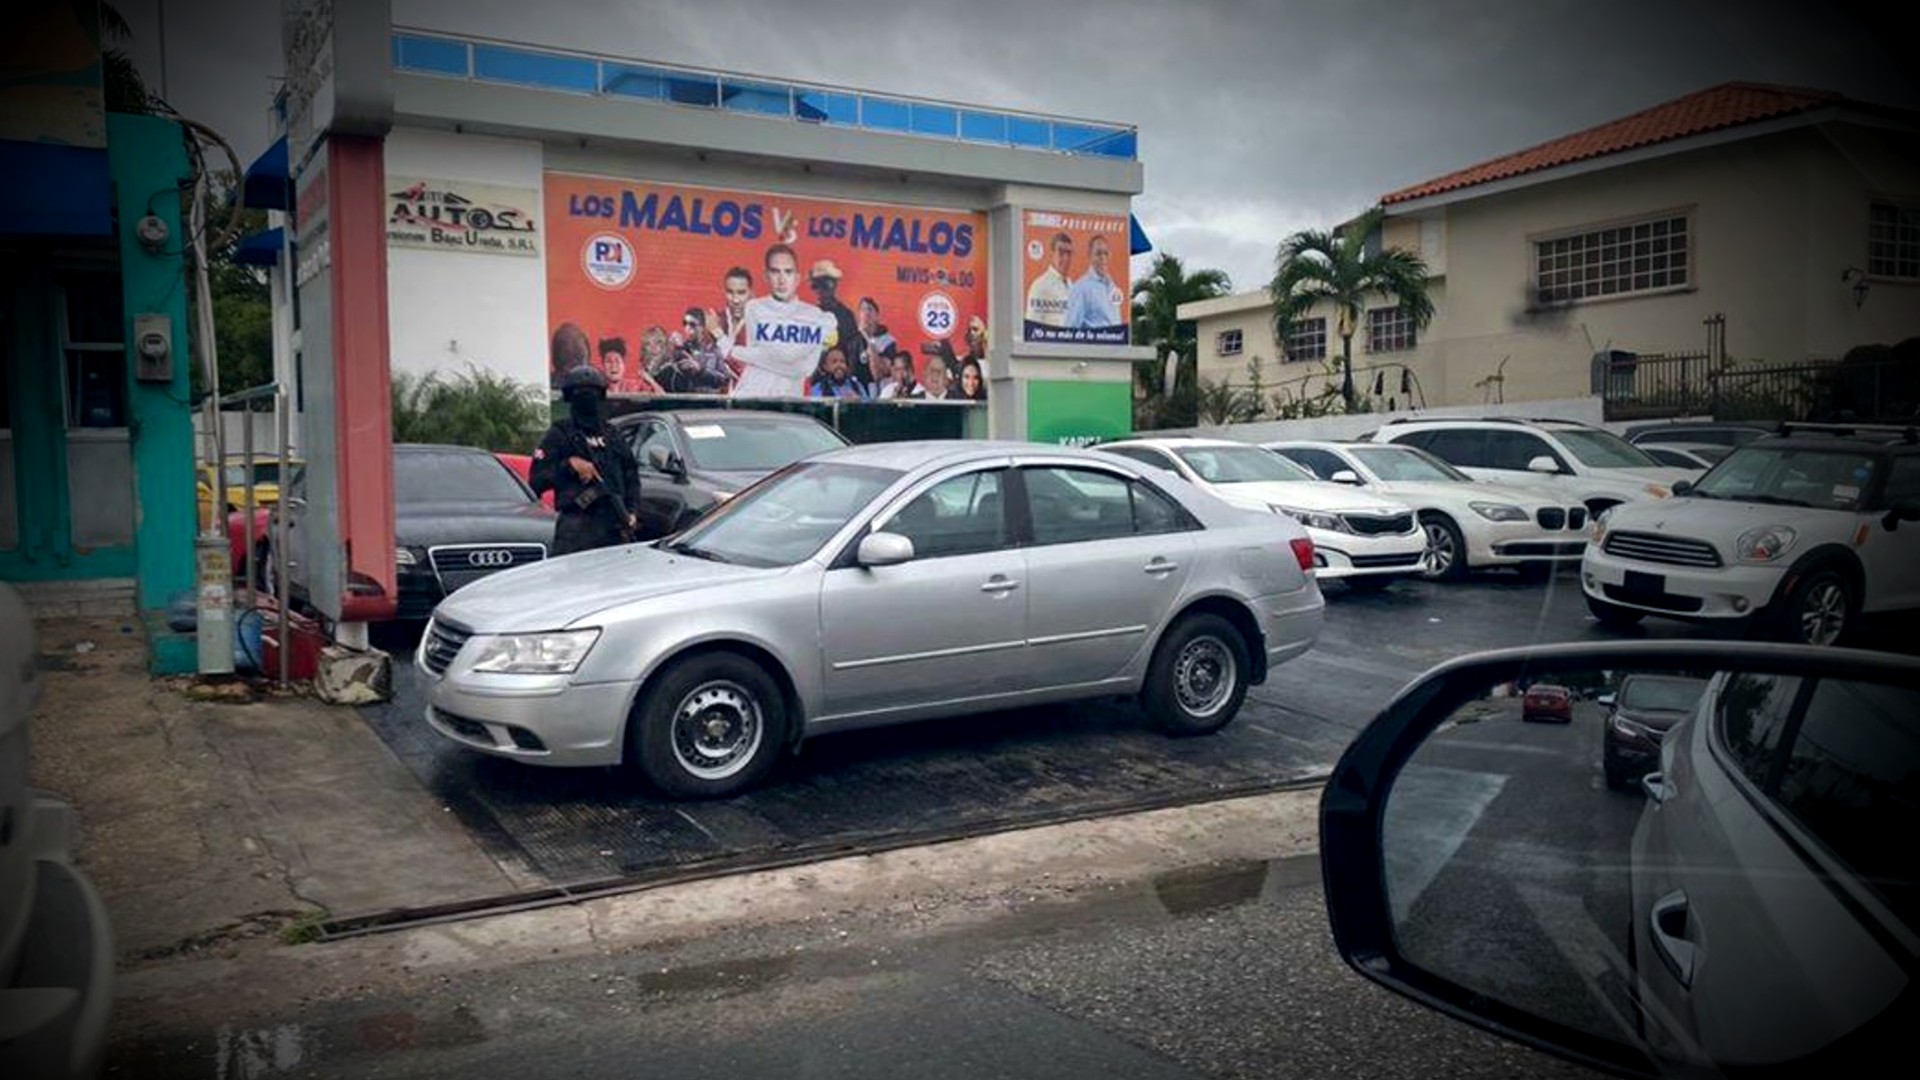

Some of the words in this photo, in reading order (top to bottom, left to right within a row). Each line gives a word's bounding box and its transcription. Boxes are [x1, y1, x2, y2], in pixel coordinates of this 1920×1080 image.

[389, 203, 521, 231] AUTOS
[569, 194, 614, 218] LOS
[620, 190, 763, 240] MALOS
[808, 216, 848, 239] LOS
[851, 213, 973, 257] MALOS
[926, 310, 950, 328] 23
[756, 323, 821, 345] KARIM
